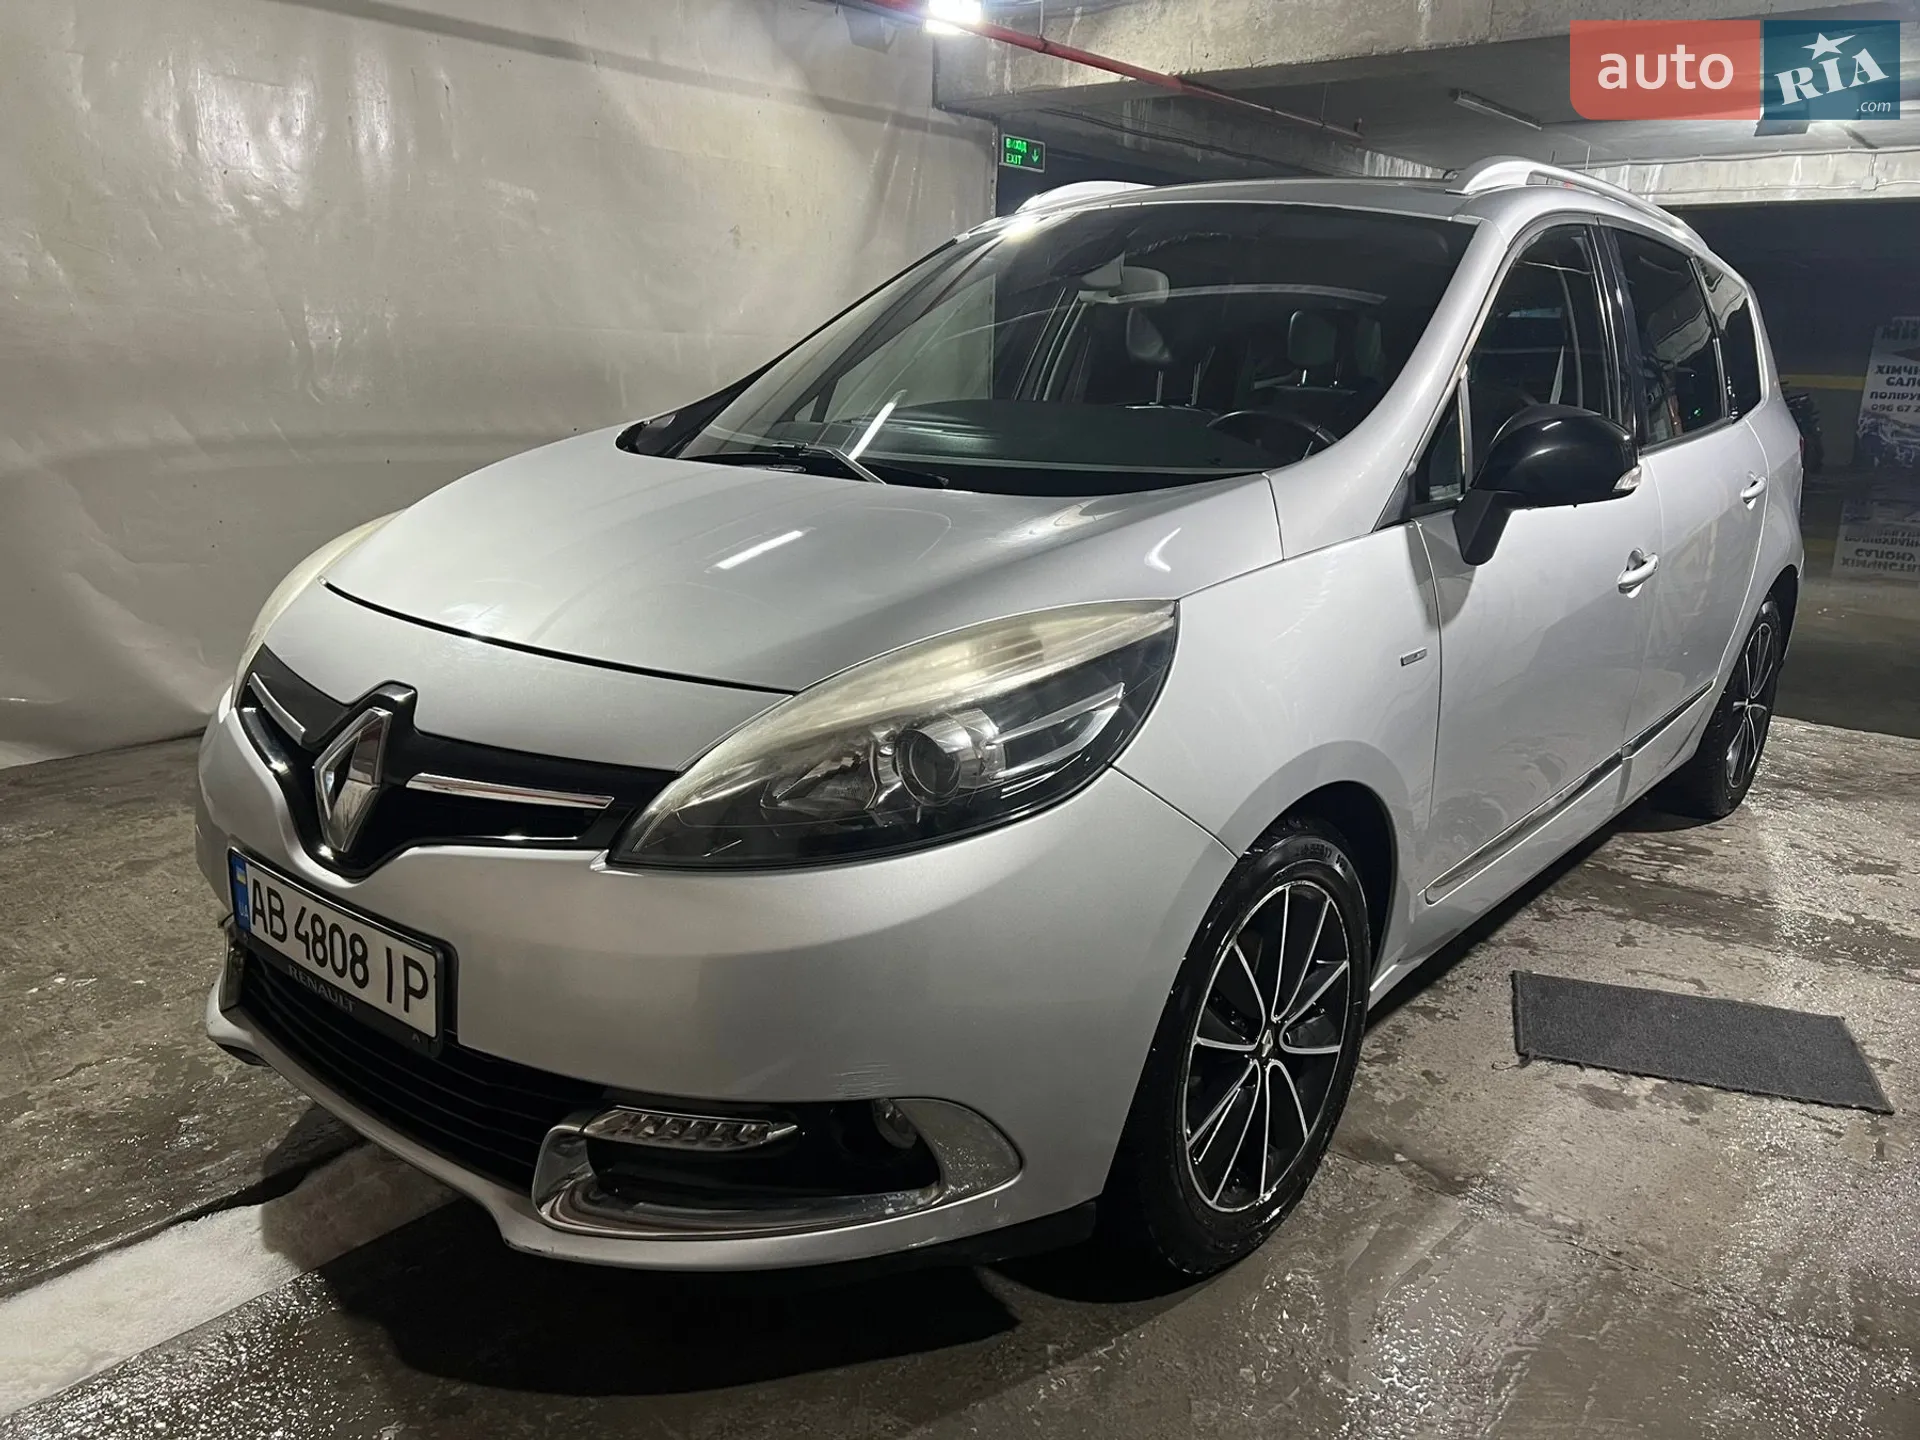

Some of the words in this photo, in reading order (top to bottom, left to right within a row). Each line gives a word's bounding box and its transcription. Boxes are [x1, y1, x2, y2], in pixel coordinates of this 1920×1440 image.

[1006, 153, 1022, 165] EXIT
[252, 878, 288, 943] AB
[294, 906, 369, 989] 4808
[385, 947, 429, 1013] IP
[288, 964, 356, 1012] RENAULT
